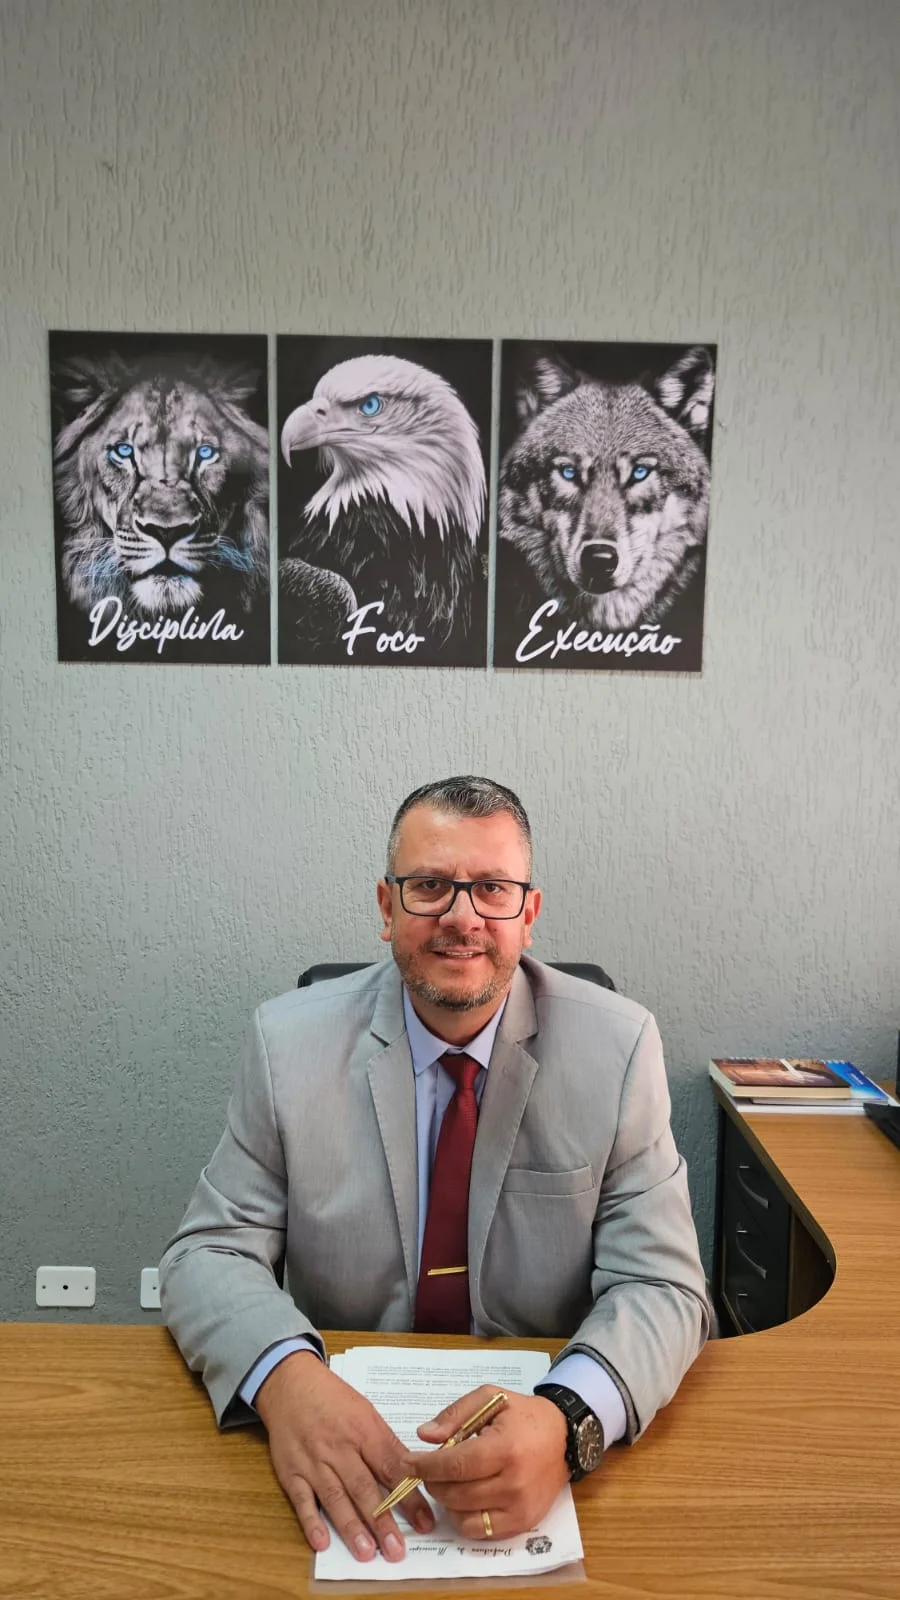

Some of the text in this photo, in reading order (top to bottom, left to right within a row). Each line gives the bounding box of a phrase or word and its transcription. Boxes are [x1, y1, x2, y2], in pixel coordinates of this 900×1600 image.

[88, 596, 244, 654] Disciplina
[341, 601, 425, 656] Foco
[515, 600, 682, 662] Execução
